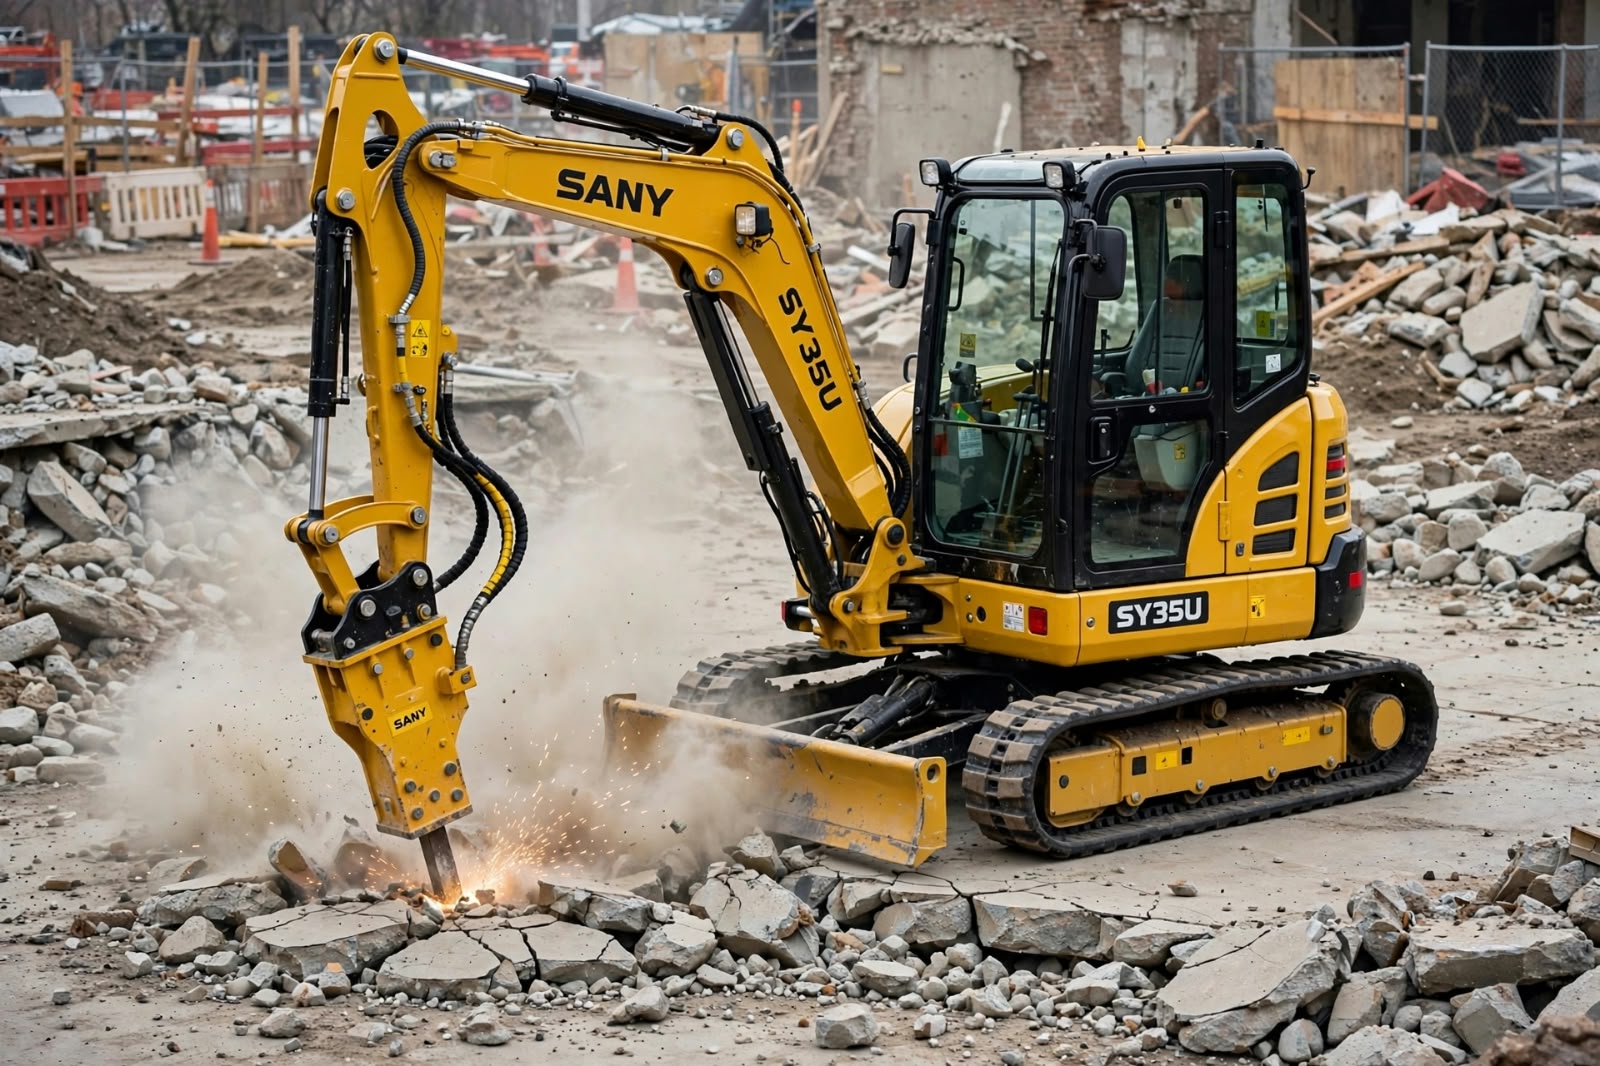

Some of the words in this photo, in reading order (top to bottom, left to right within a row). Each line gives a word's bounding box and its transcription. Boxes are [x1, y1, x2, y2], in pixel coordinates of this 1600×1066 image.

[556, 168, 674, 217] SANY
[778, 287, 843, 411] SY35U
[1116, 597, 1202, 628] SY35U
[393, 706, 426, 730] SANY
